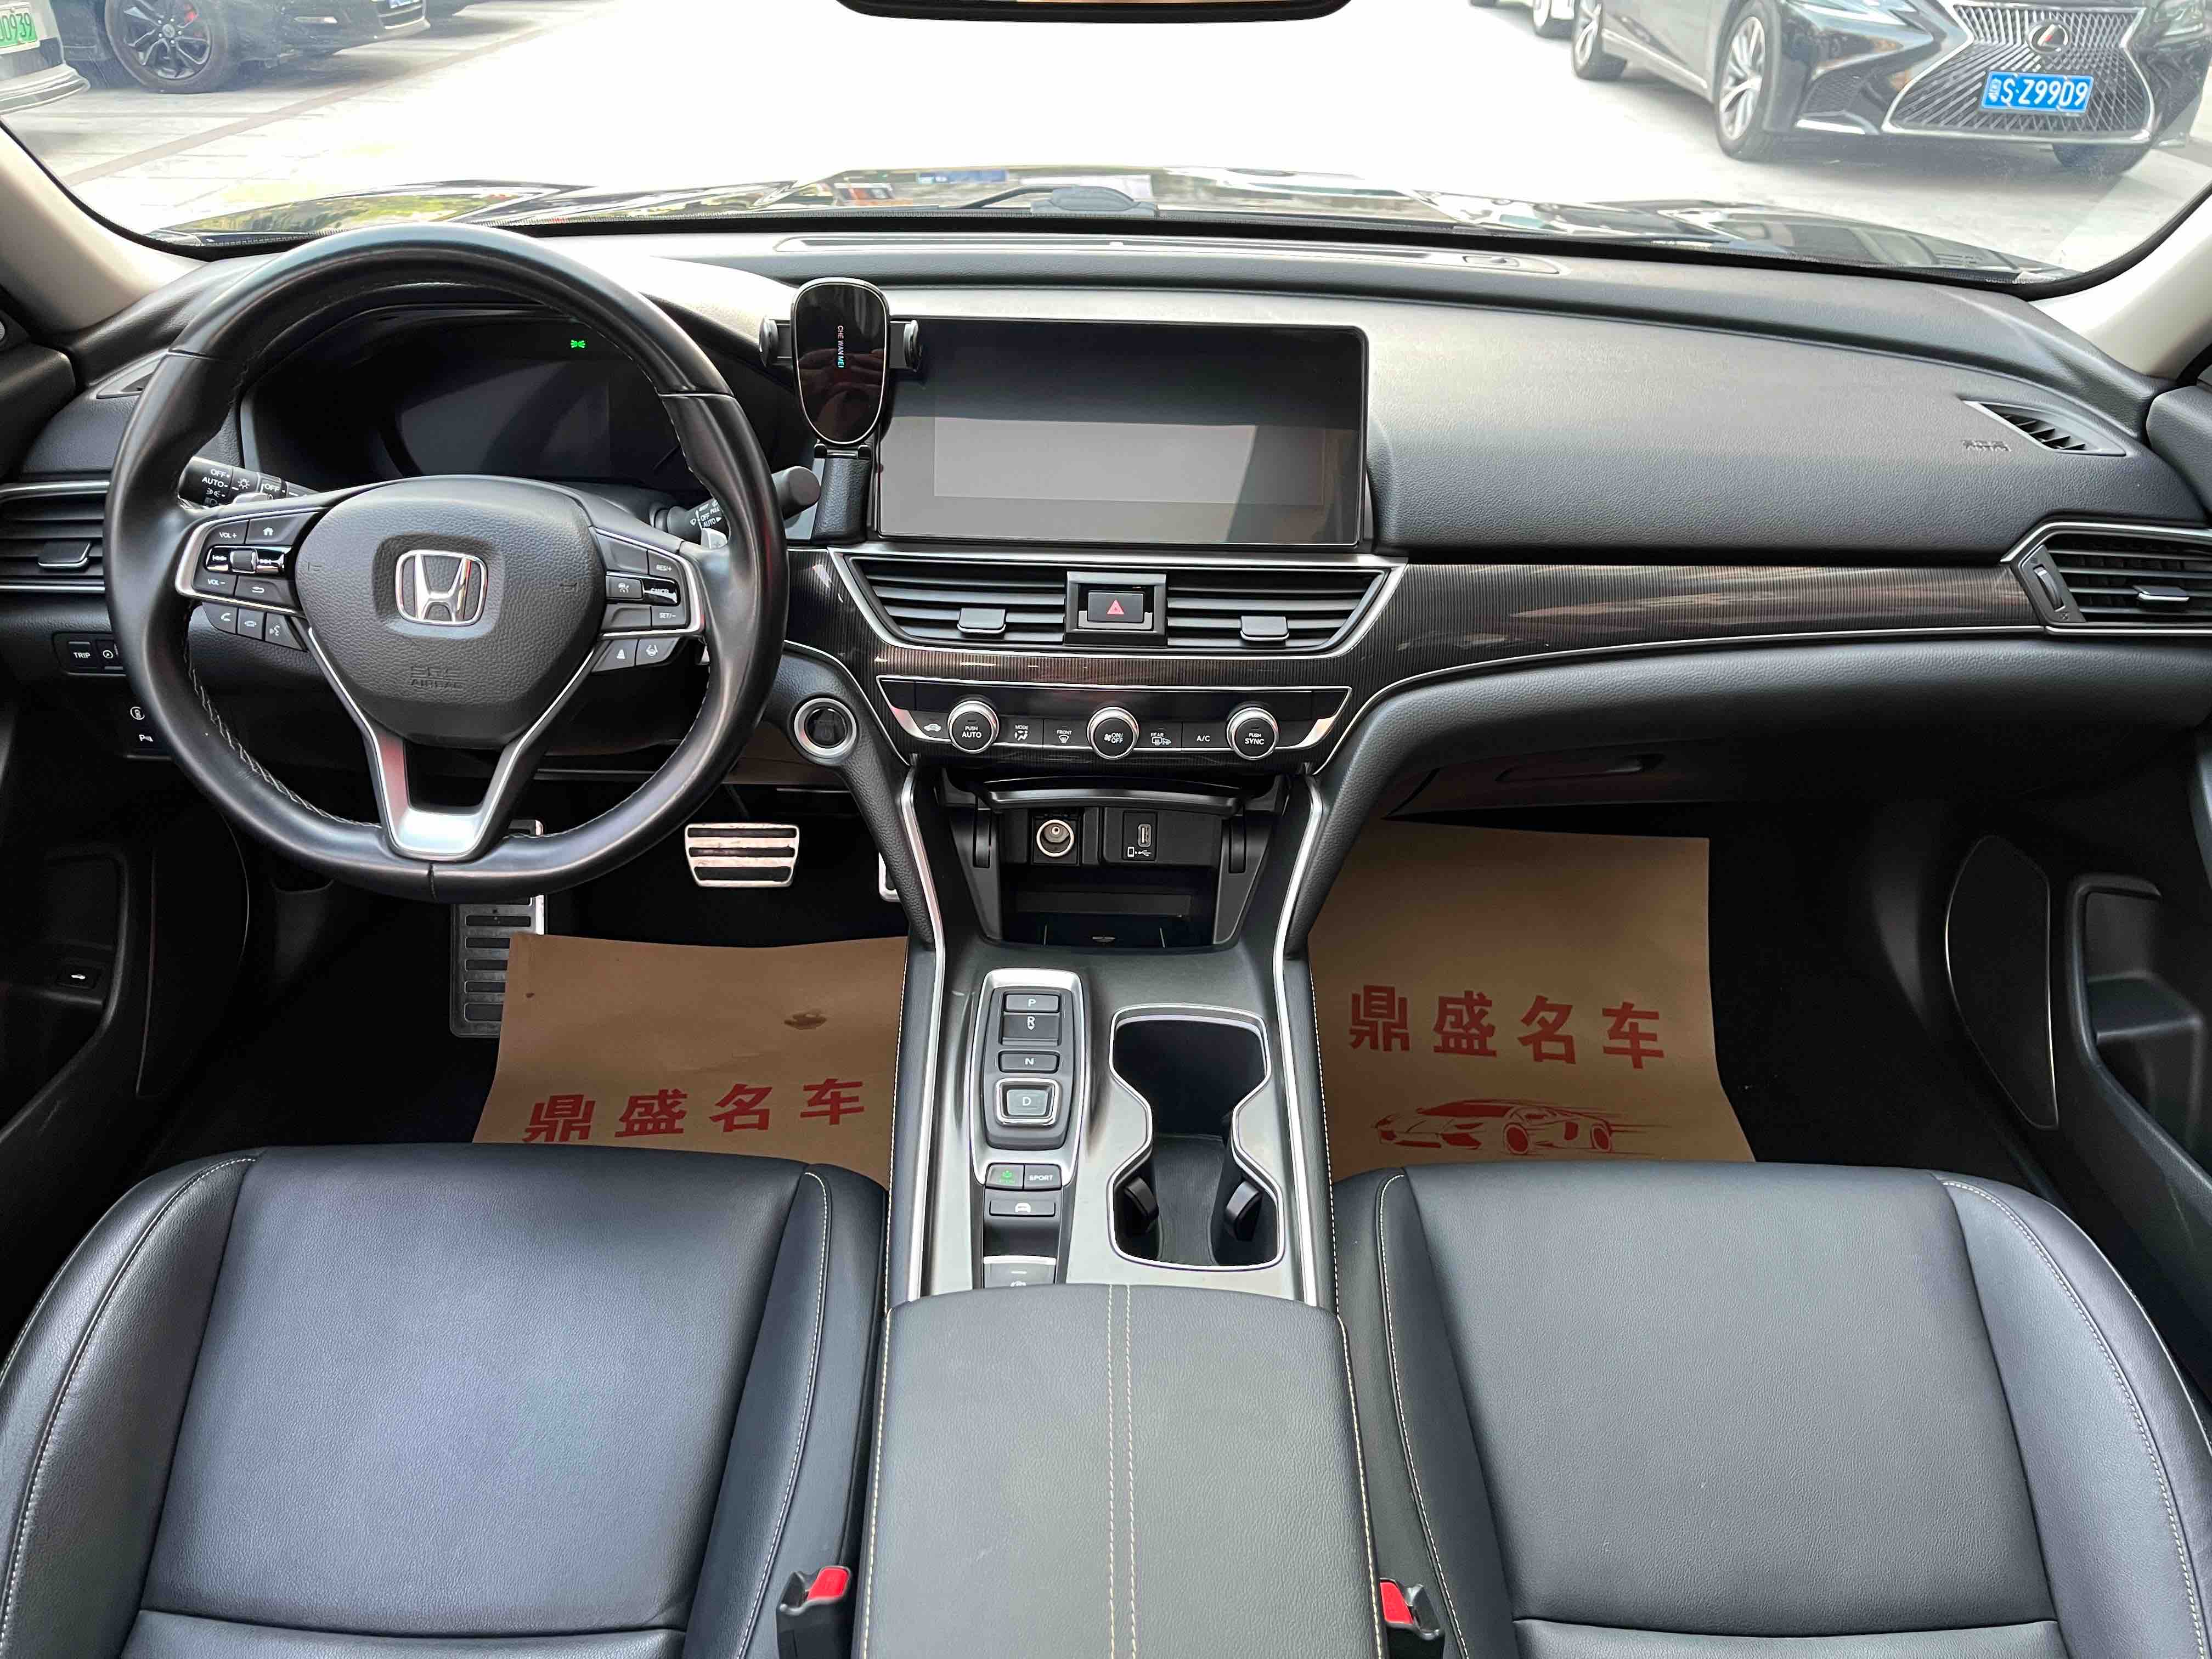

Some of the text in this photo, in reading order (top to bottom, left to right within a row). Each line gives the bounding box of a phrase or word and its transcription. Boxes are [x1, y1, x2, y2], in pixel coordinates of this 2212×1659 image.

[211, 469, 225, 478] OFF
[202, 477, 224, 488] AUTO
[264, 483, 280, 492] OFF
[1028, 998, 1036, 1007] P
[1348, 985, 1664, 1070] 鼎盛名车
[1022, 1097, 1031, 1106] D
[522, 1079, 865, 1142] 鼎盛名车
